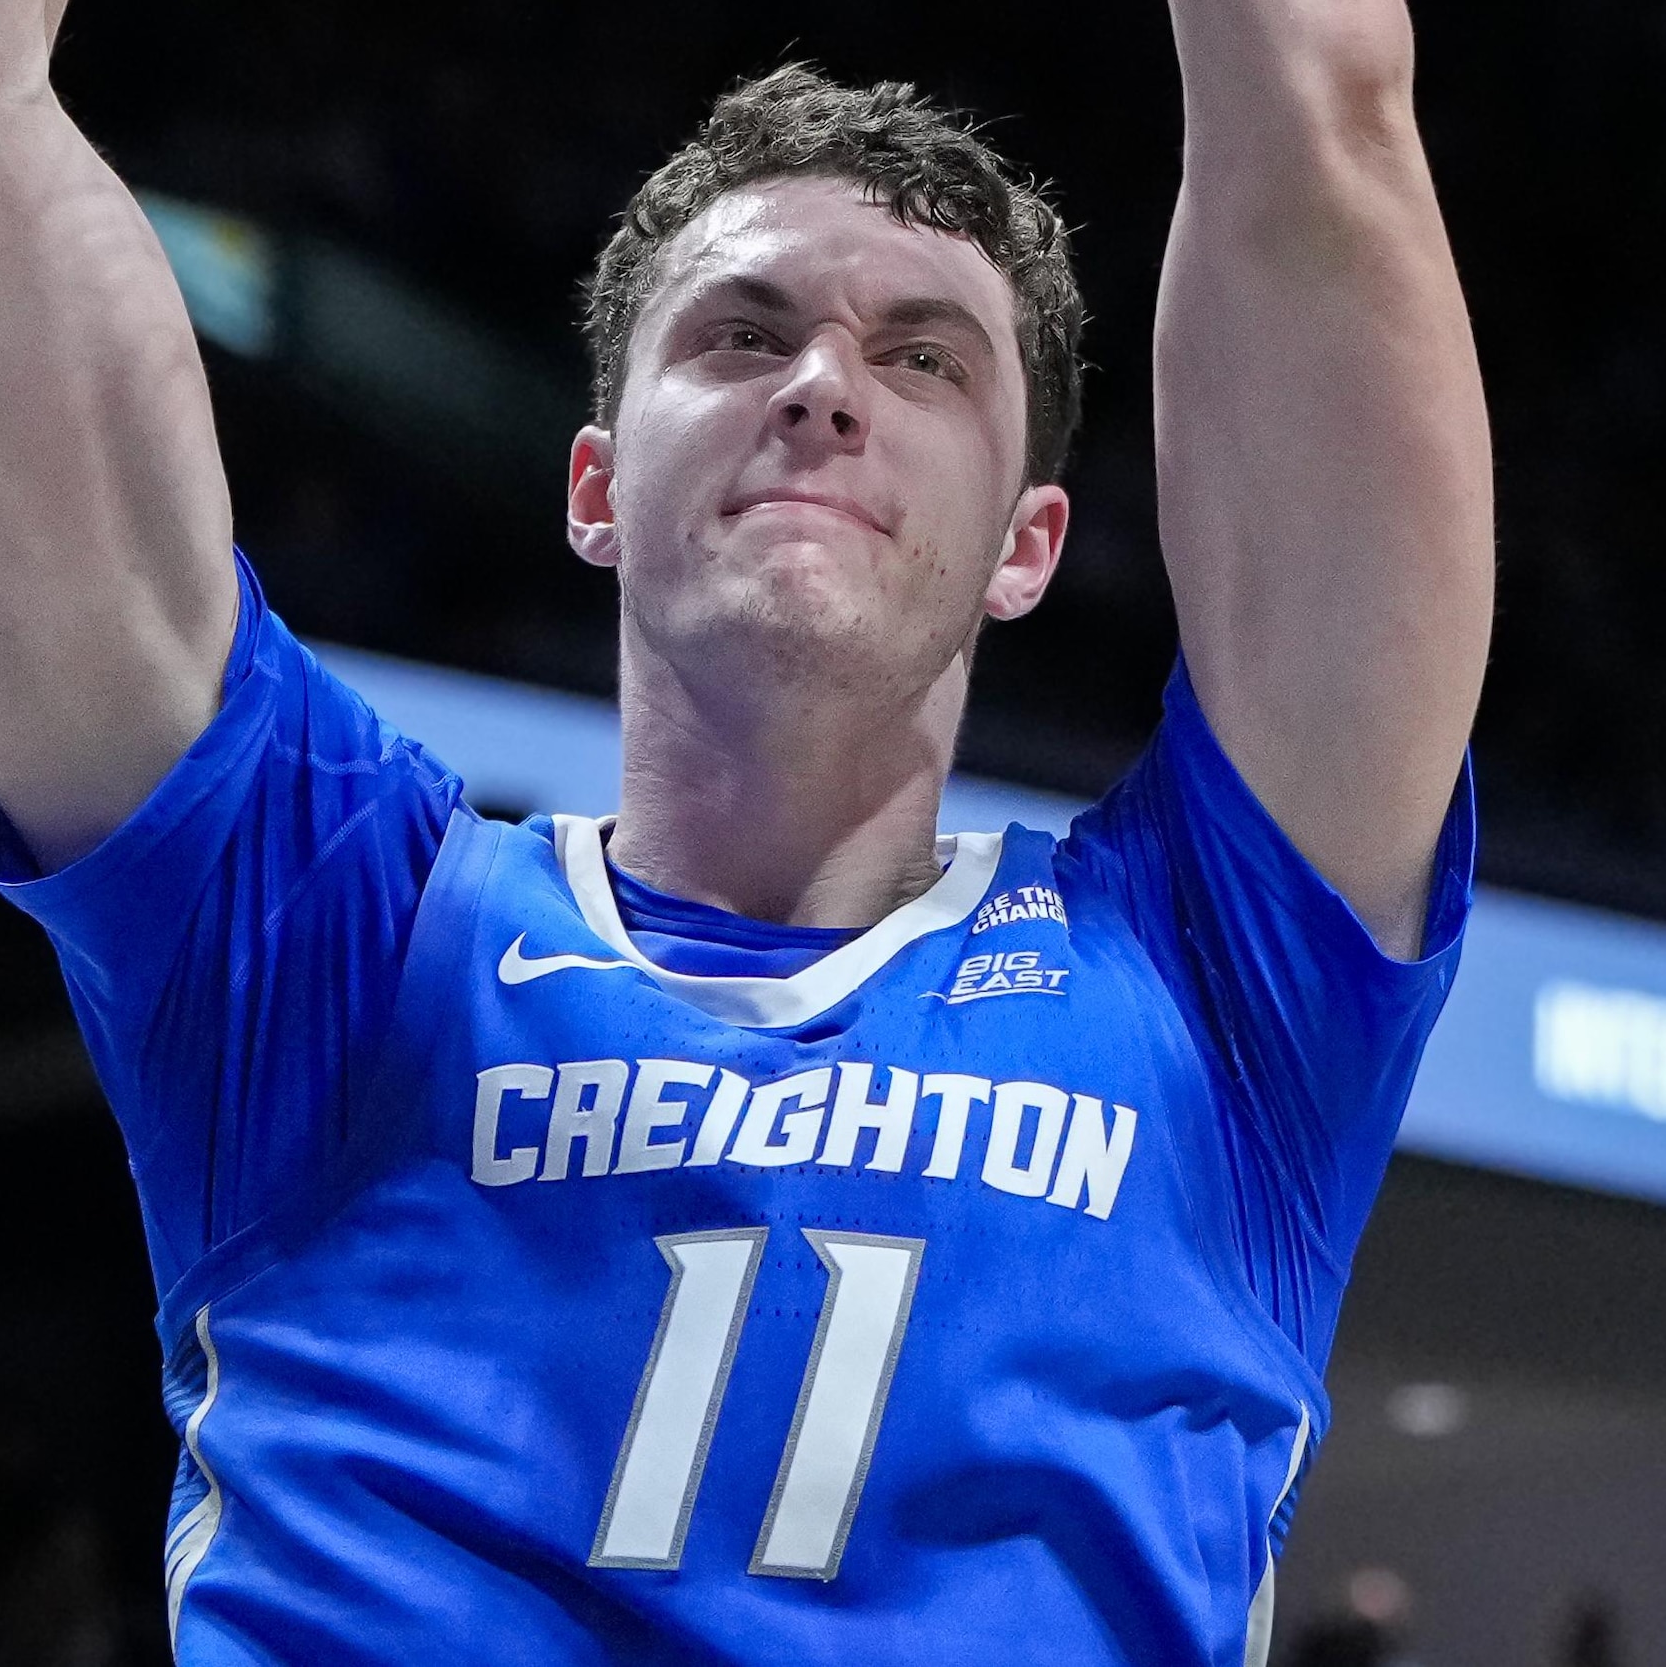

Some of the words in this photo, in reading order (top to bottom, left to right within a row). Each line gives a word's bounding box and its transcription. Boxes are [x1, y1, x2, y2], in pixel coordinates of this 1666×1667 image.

[977, 893, 1012, 920] BE
[1017, 886, 1065, 910] THE
[956, 951, 1041, 978] BIG
[949, 969, 1070, 996] EAST
[469, 1058, 1137, 1221] CREIGHTON
[585, 1226, 927, 1582] 11
